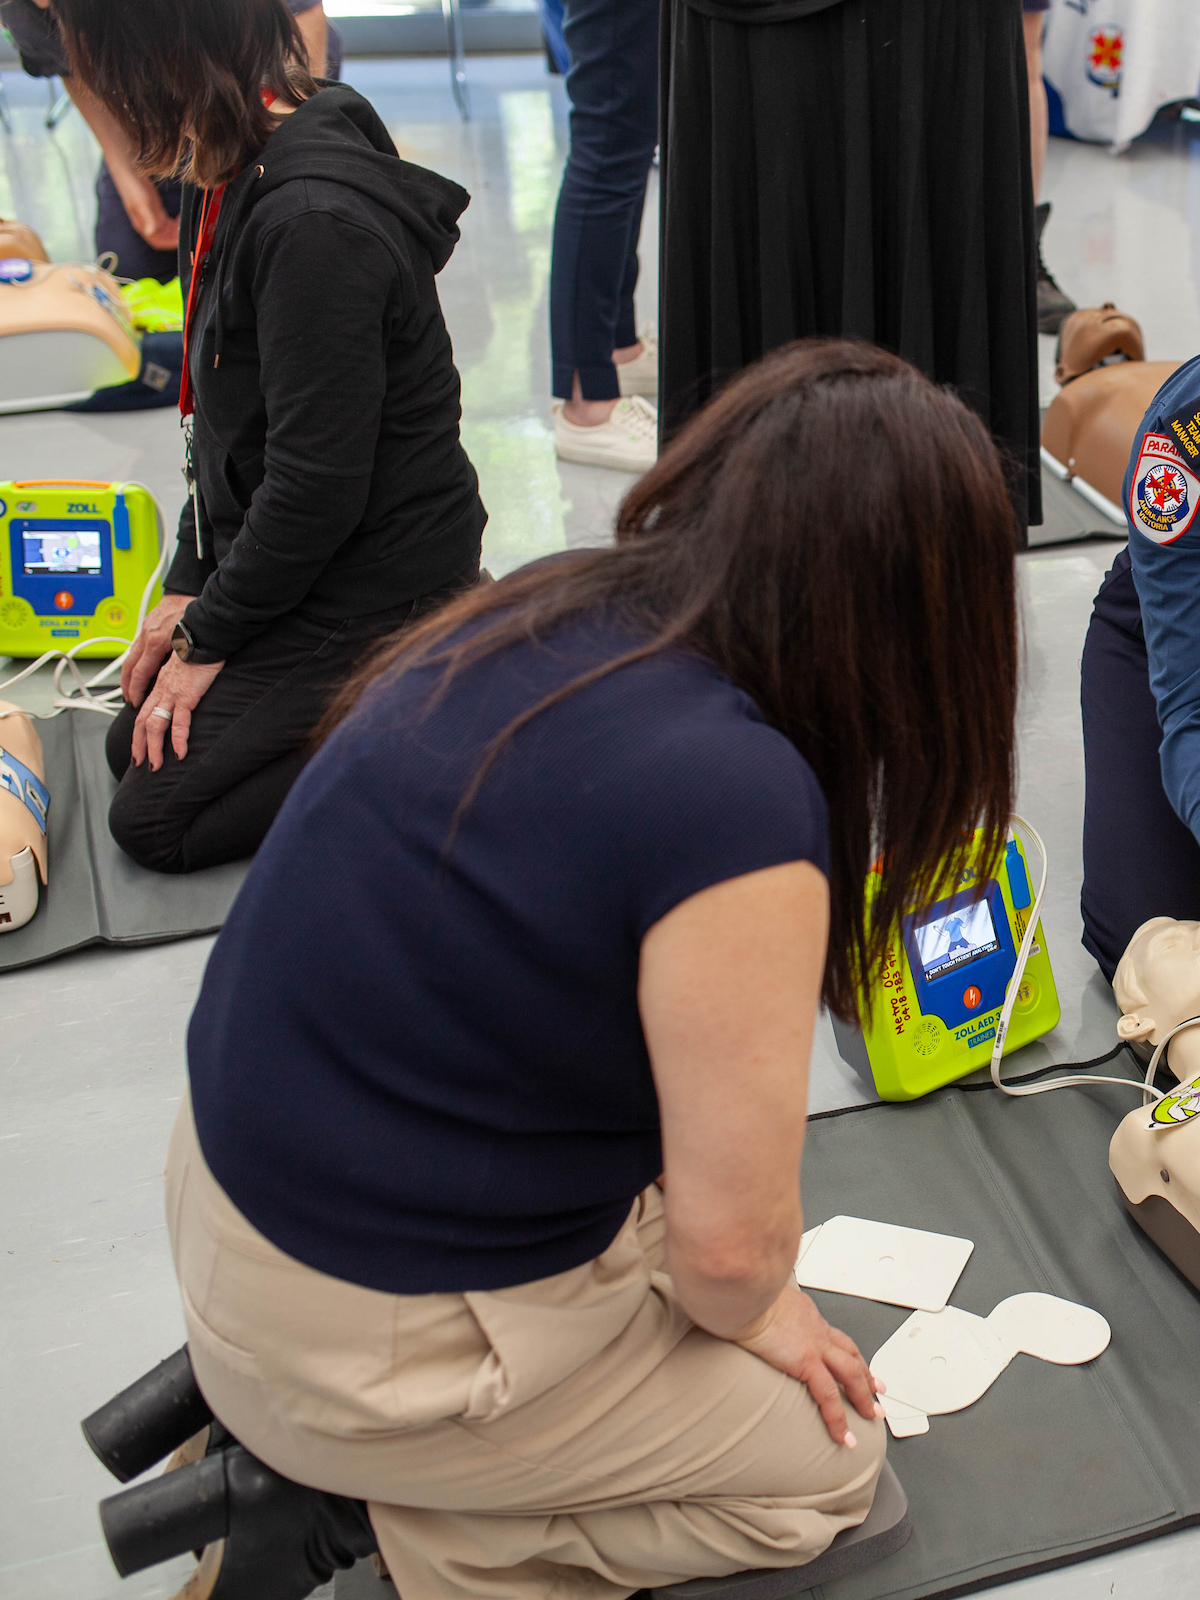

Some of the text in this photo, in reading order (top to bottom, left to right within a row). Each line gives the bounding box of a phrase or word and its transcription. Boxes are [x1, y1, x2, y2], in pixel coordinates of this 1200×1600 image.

[1146, 439, 1182, 459] PARA
[1170, 419, 1200, 459] MANAGER
[66, 503, 100, 514] ZOLL
[1138, 499, 1177, 524] AMBULANCE
[1138, 511, 1169, 532] VICTORIA
[942, 960, 956, 970] TOUCH
[892, 970, 904, 993] 783
[890, 998, 905, 1035] Metro
[898, 995, 911, 1021] 0418
[954, 1025, 976, 1041] ZOLL
[978, 1016, 995, 1030] AED
[970, 1029, 994, 1046] TRAINER
